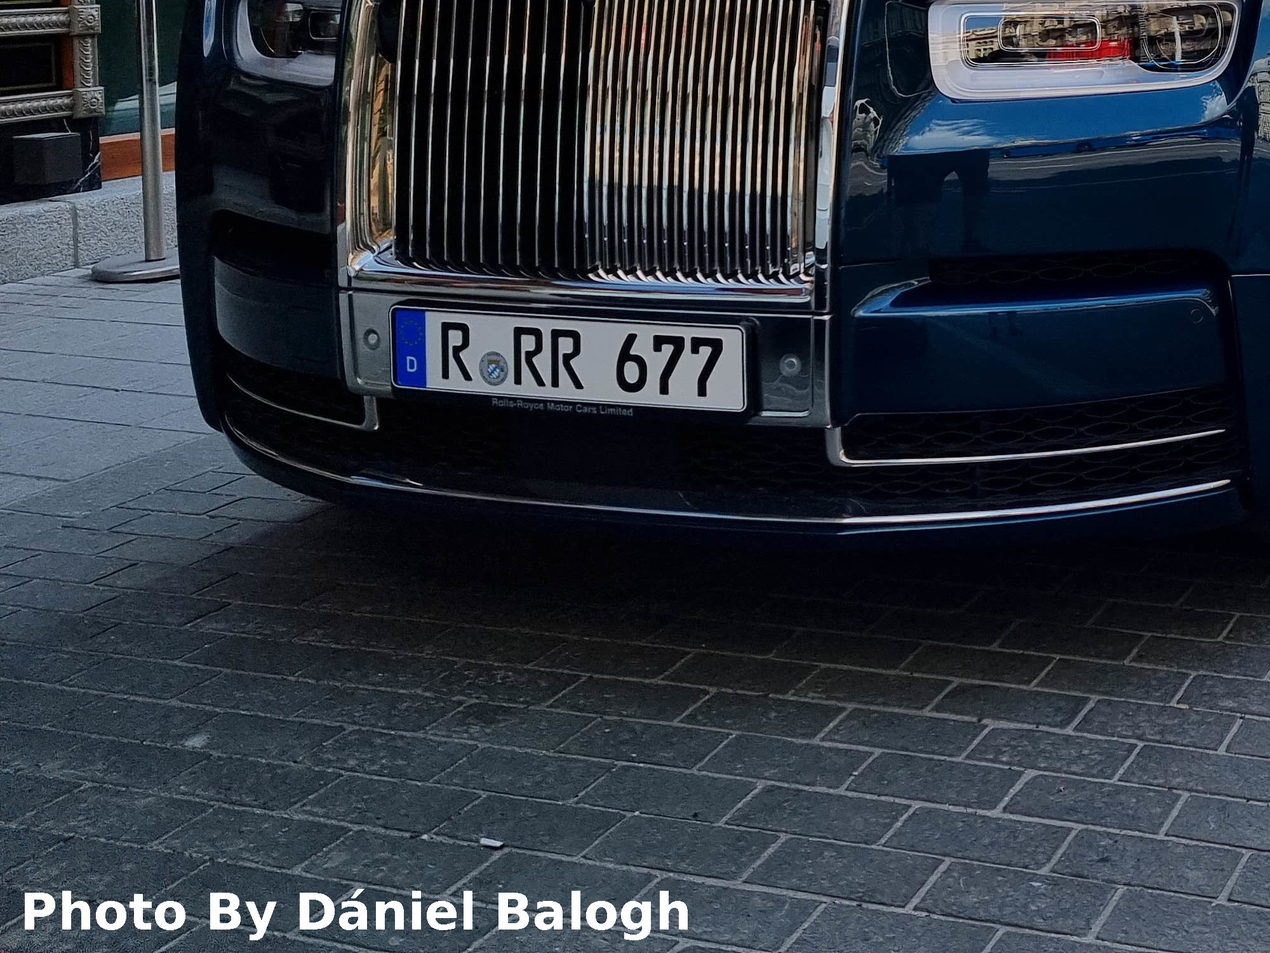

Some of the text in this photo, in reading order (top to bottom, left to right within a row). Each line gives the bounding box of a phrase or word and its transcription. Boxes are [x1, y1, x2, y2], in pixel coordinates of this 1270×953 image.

[406, 356, 417, 372] D
[441, 322, 473, 382] R
[514, 327, 585, 390] RR
[616, 333, 724, 397] 677
[491, 398, 634, 417] Rolls-Royce Motor Cars Limited
